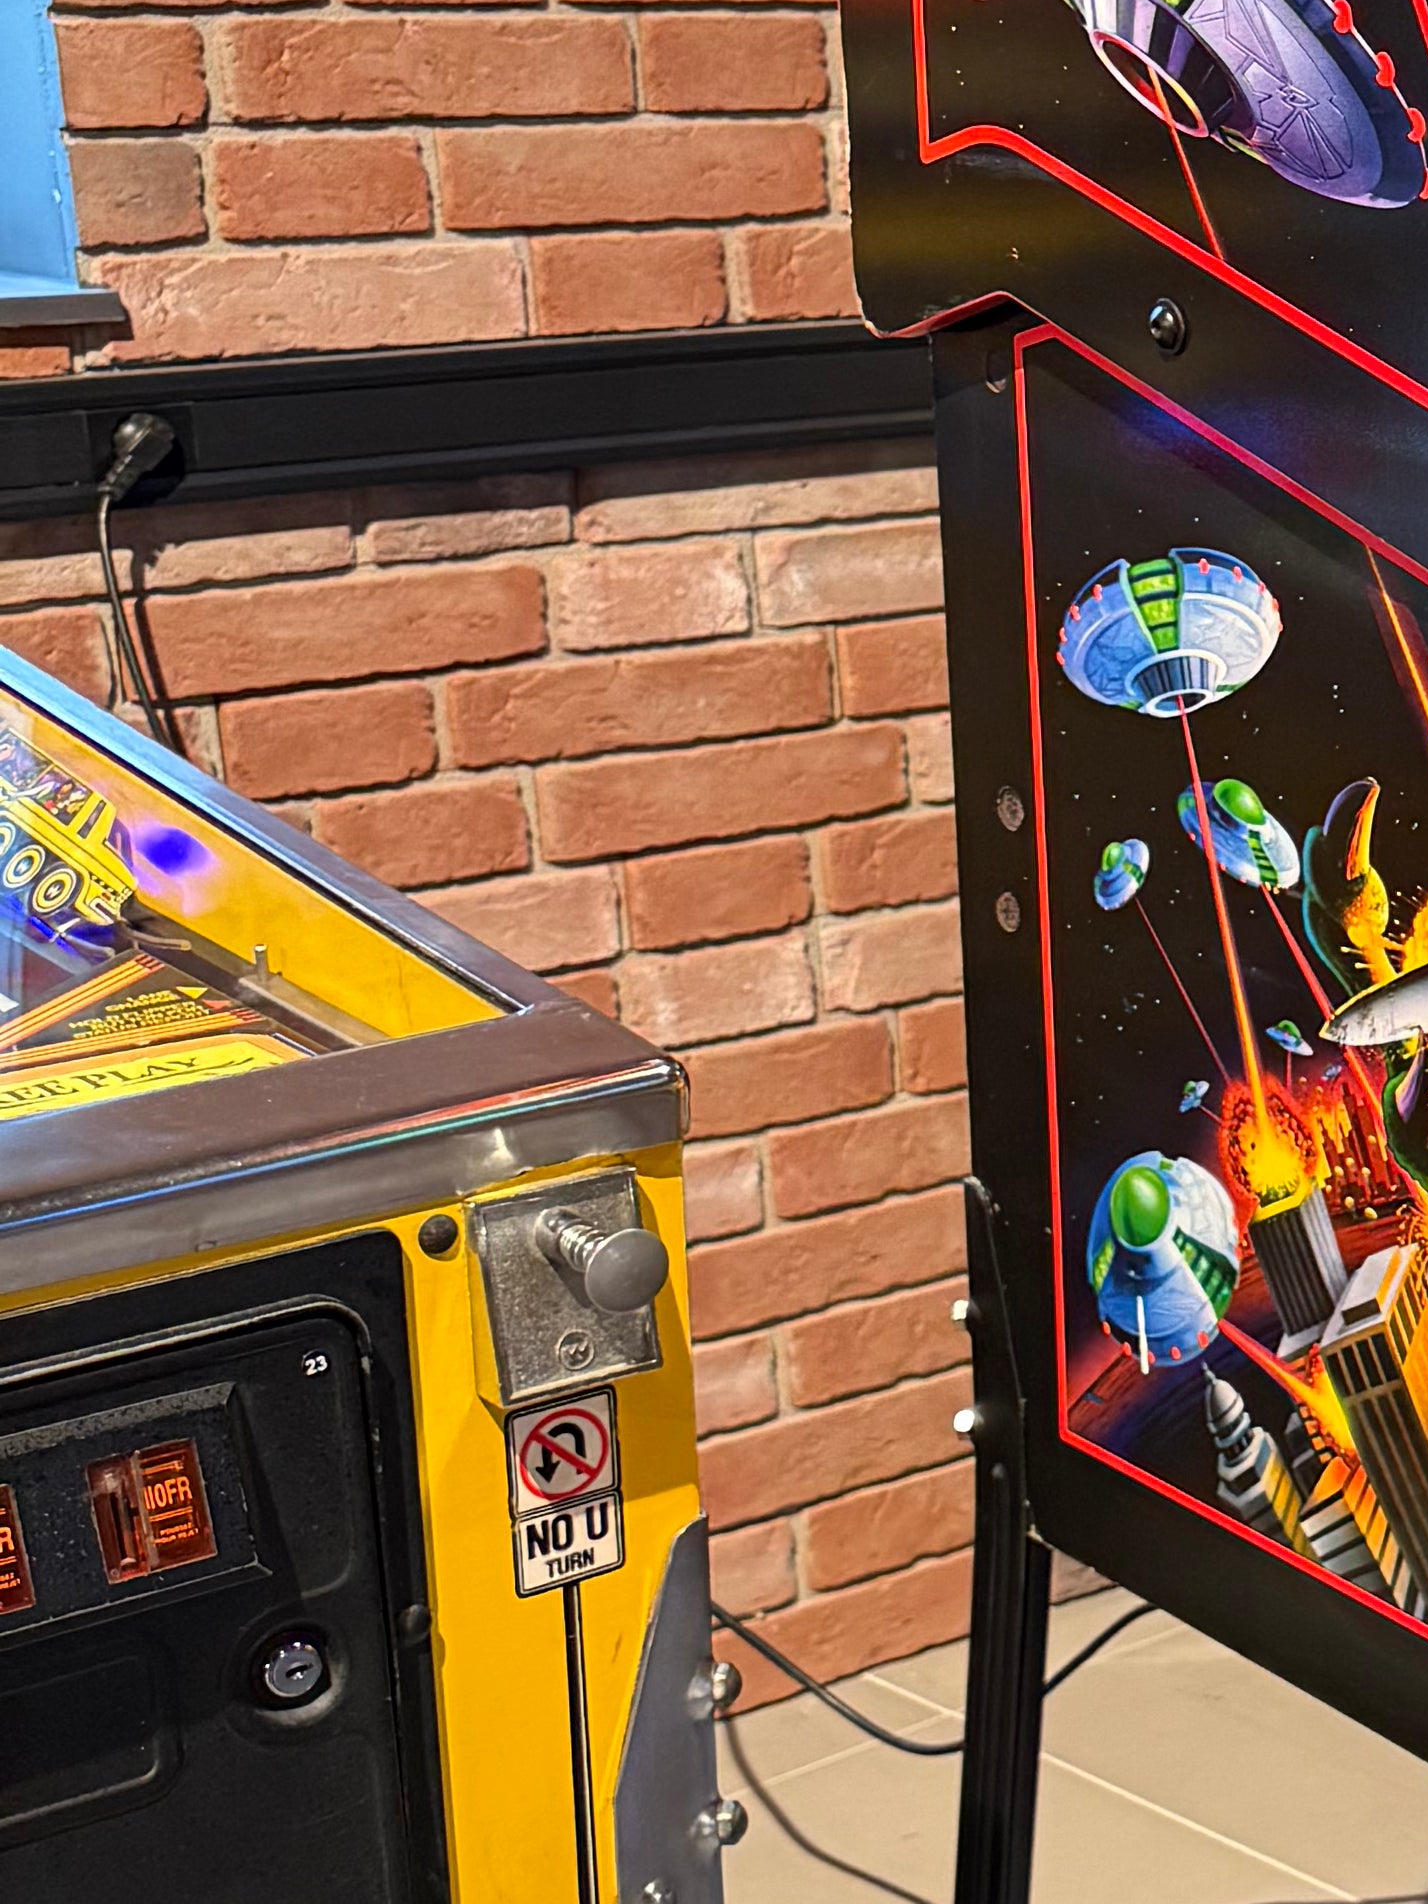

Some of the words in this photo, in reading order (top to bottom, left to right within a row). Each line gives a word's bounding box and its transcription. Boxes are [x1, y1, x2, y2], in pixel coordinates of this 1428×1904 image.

[73, 1057, 197, 1089] PLAY
[304, 1355, 328, 1376] 23
[526, 1513, 574, 1561] NO
[585, 1501, 610, 1541] U
[544, 1546, 595, 1579] TURN
